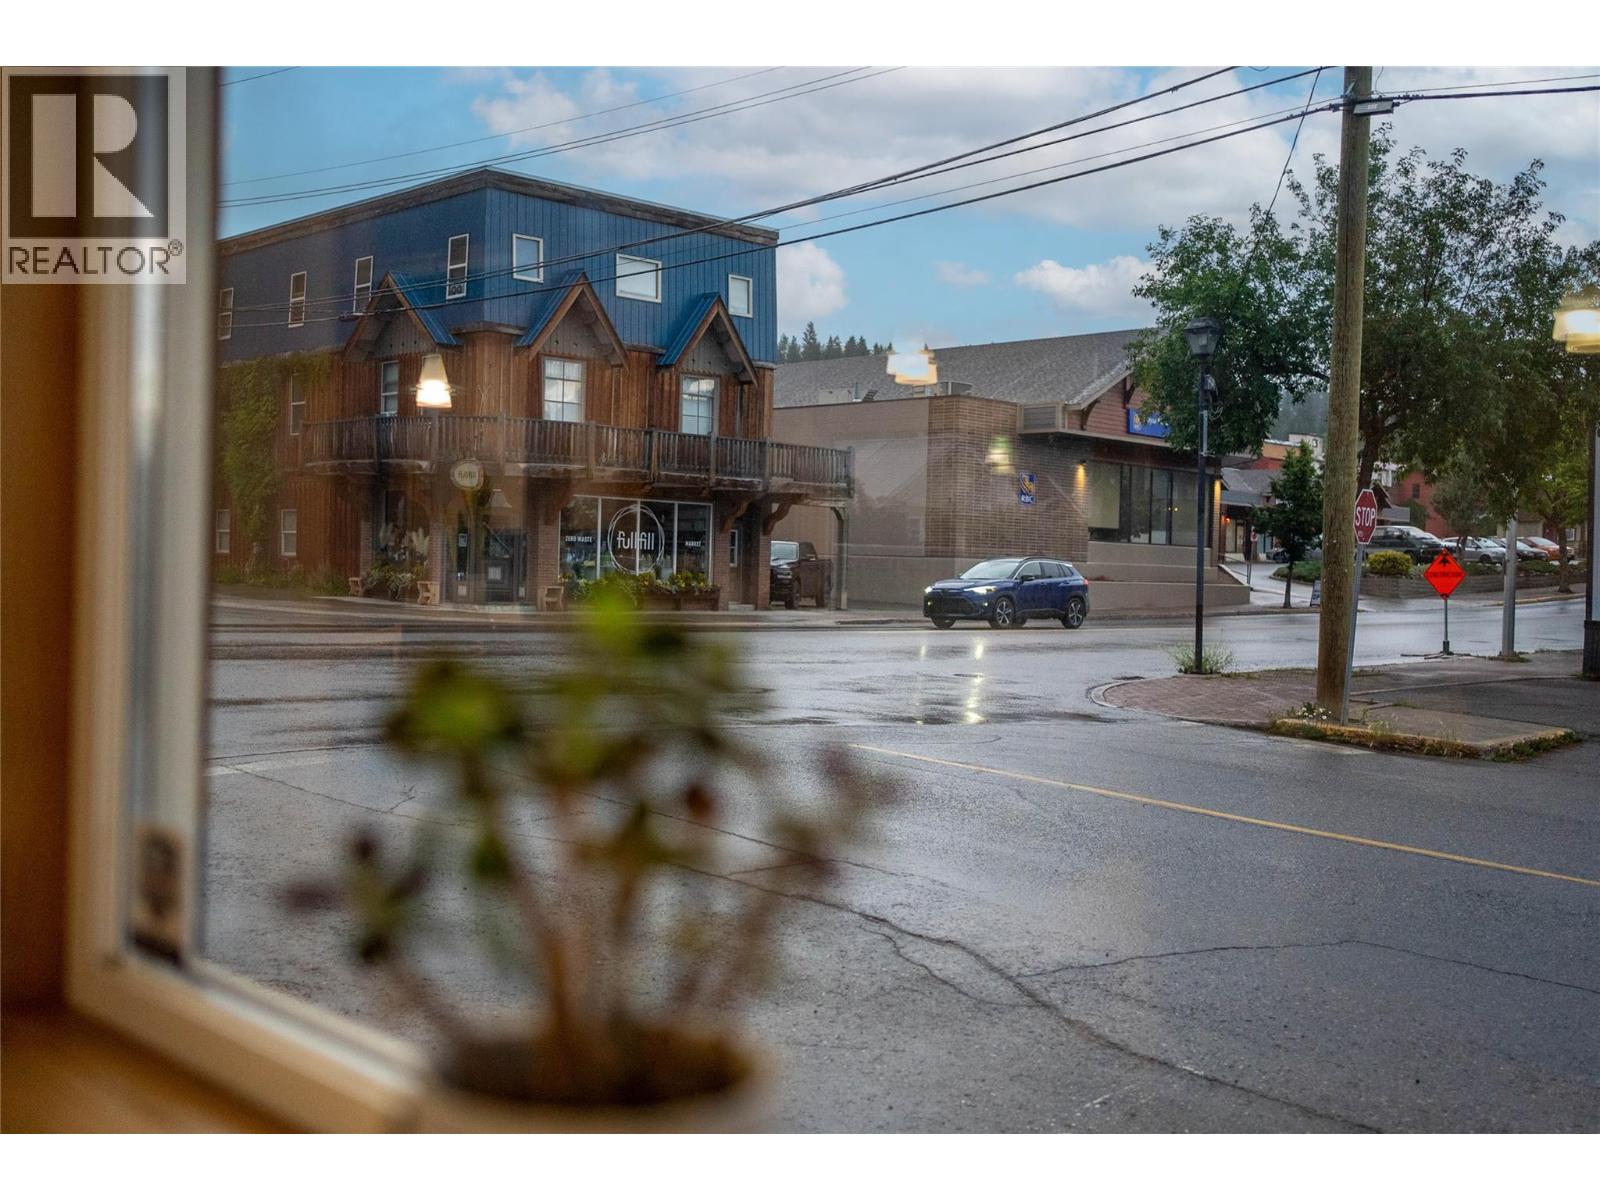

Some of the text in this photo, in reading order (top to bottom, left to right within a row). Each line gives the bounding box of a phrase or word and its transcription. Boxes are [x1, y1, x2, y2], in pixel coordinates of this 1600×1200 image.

[1020, 494, 1034, 503] RBC
[1355, 506, 1376, 527] STOP
[577, 535, 592, 543] WASTE
